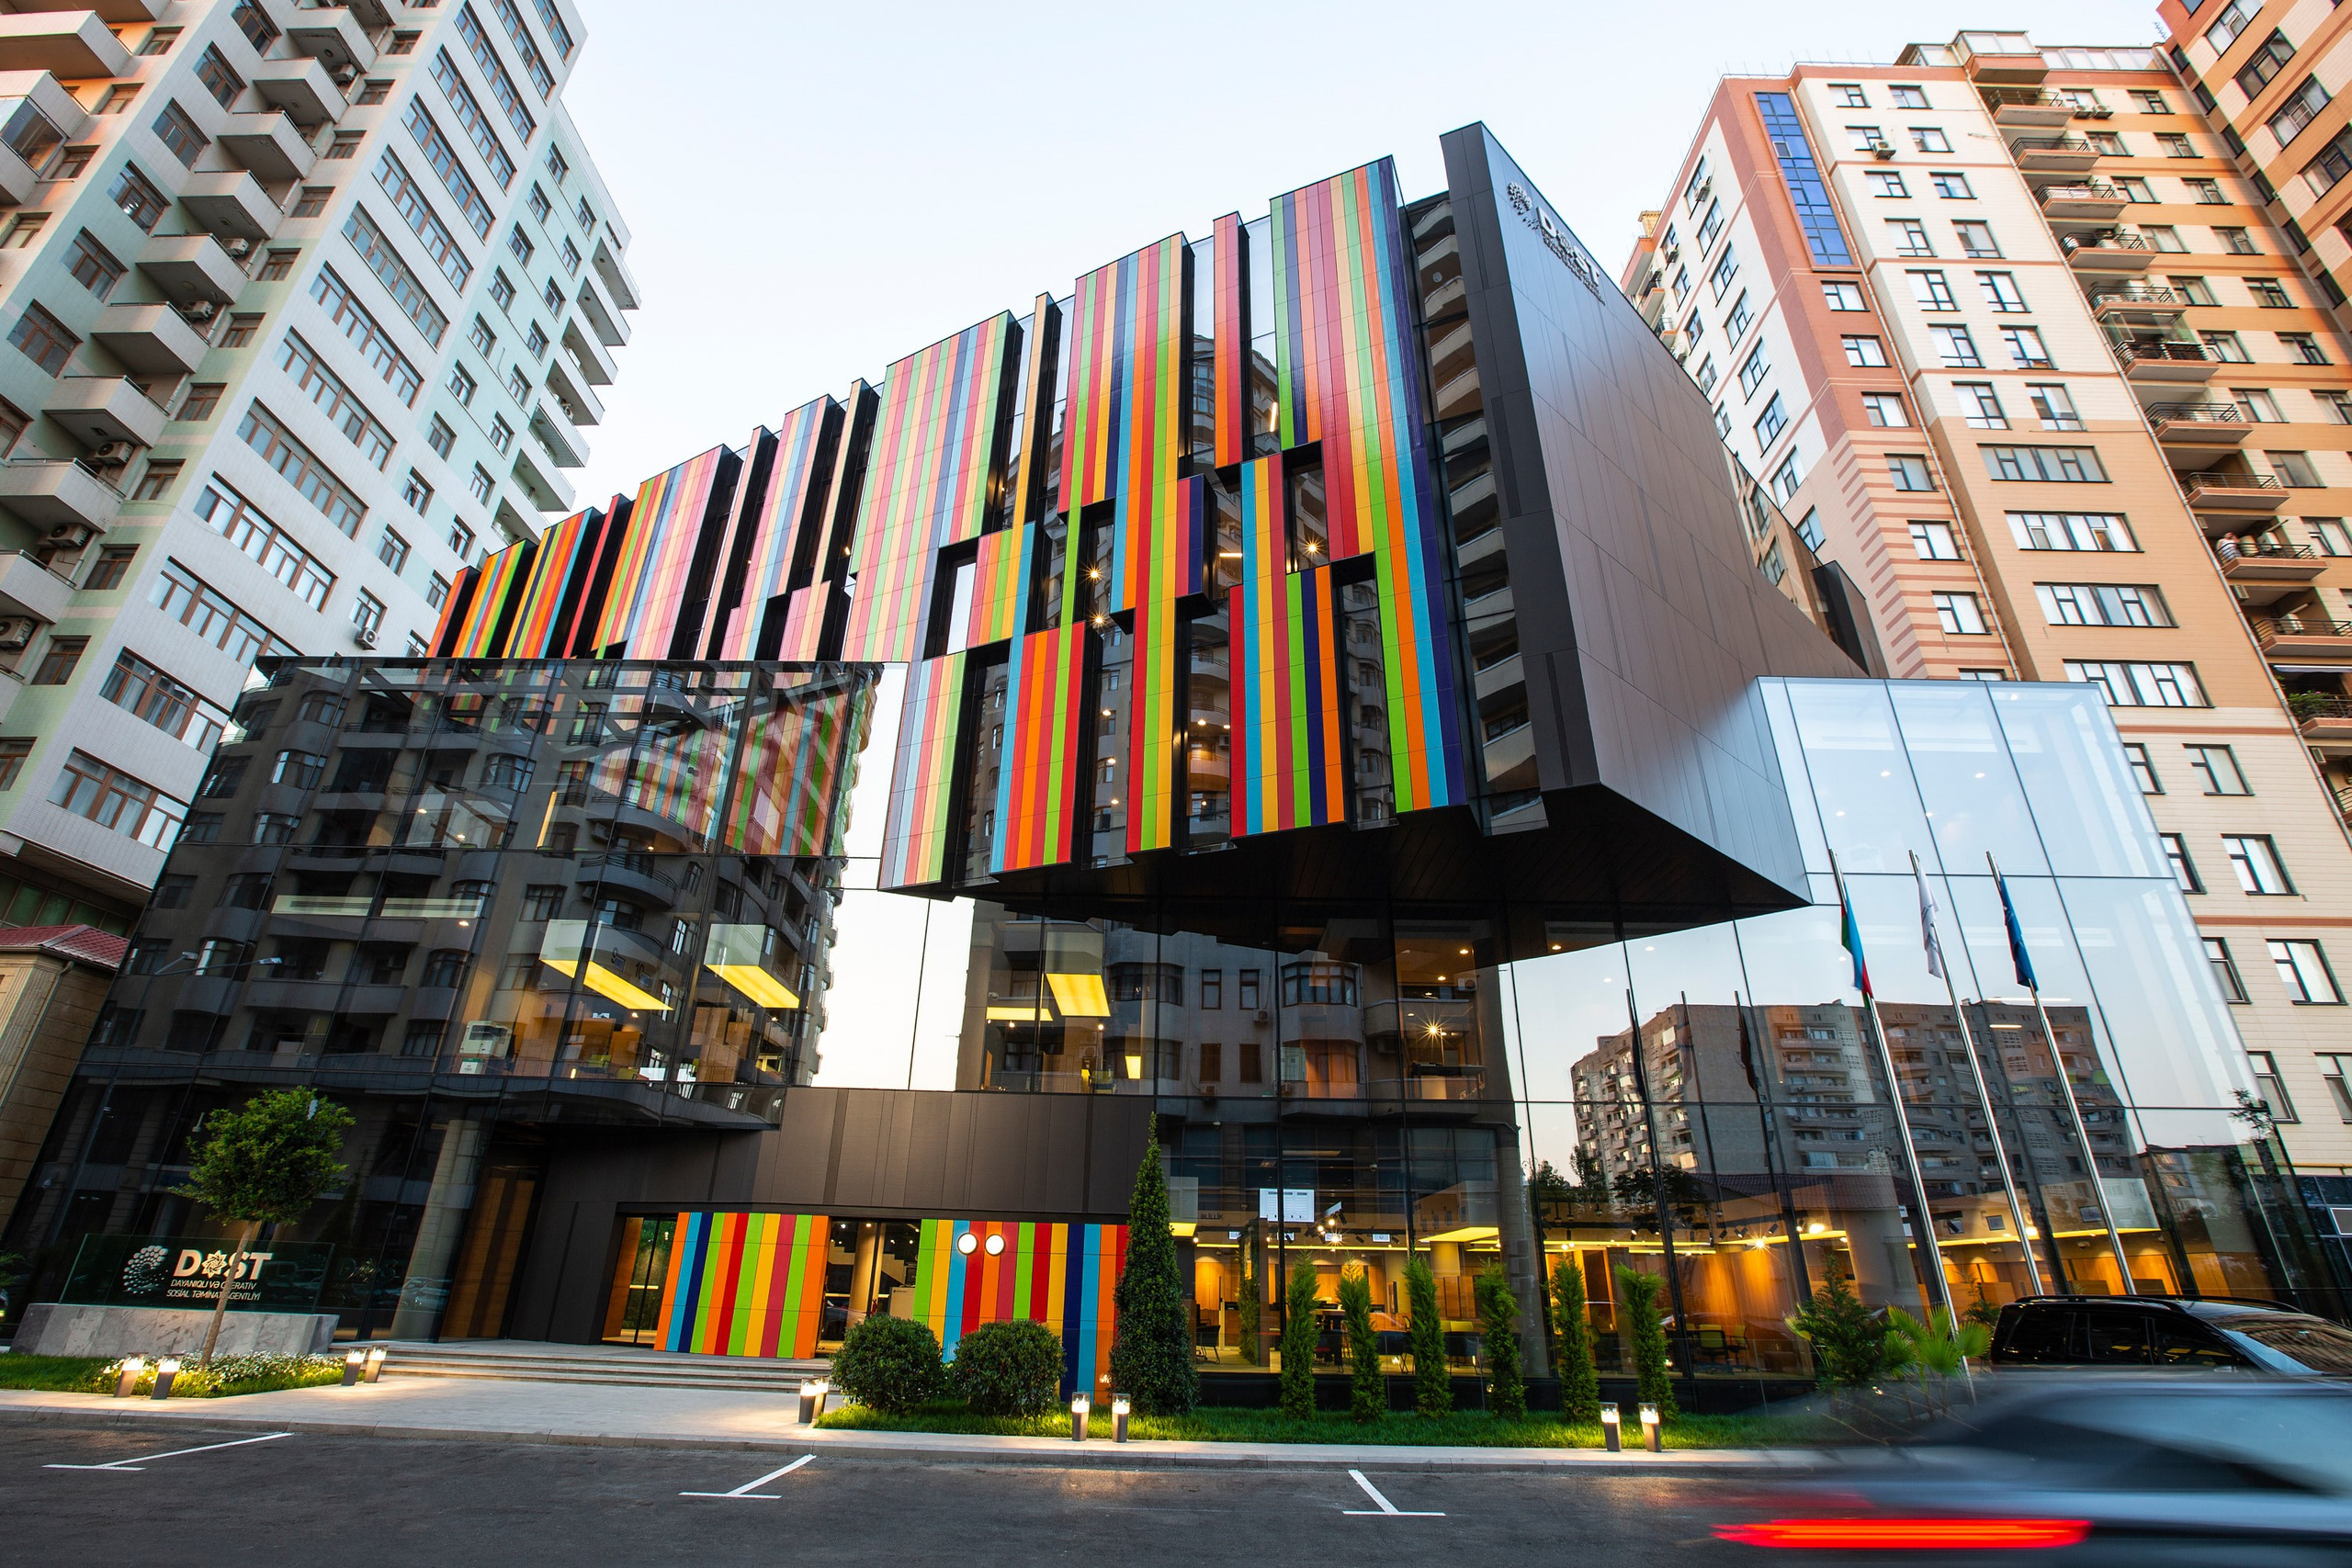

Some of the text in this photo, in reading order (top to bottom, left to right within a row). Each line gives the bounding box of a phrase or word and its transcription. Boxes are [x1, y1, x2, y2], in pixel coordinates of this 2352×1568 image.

[170, 1280, 209, 1288] DAYANIQLI
[220, 1280, 257, 1290] OERATİV
[166, 1289, 190, 1298] SOSİAL
[226, 1292, 262, 1301] GENTLİYİ
